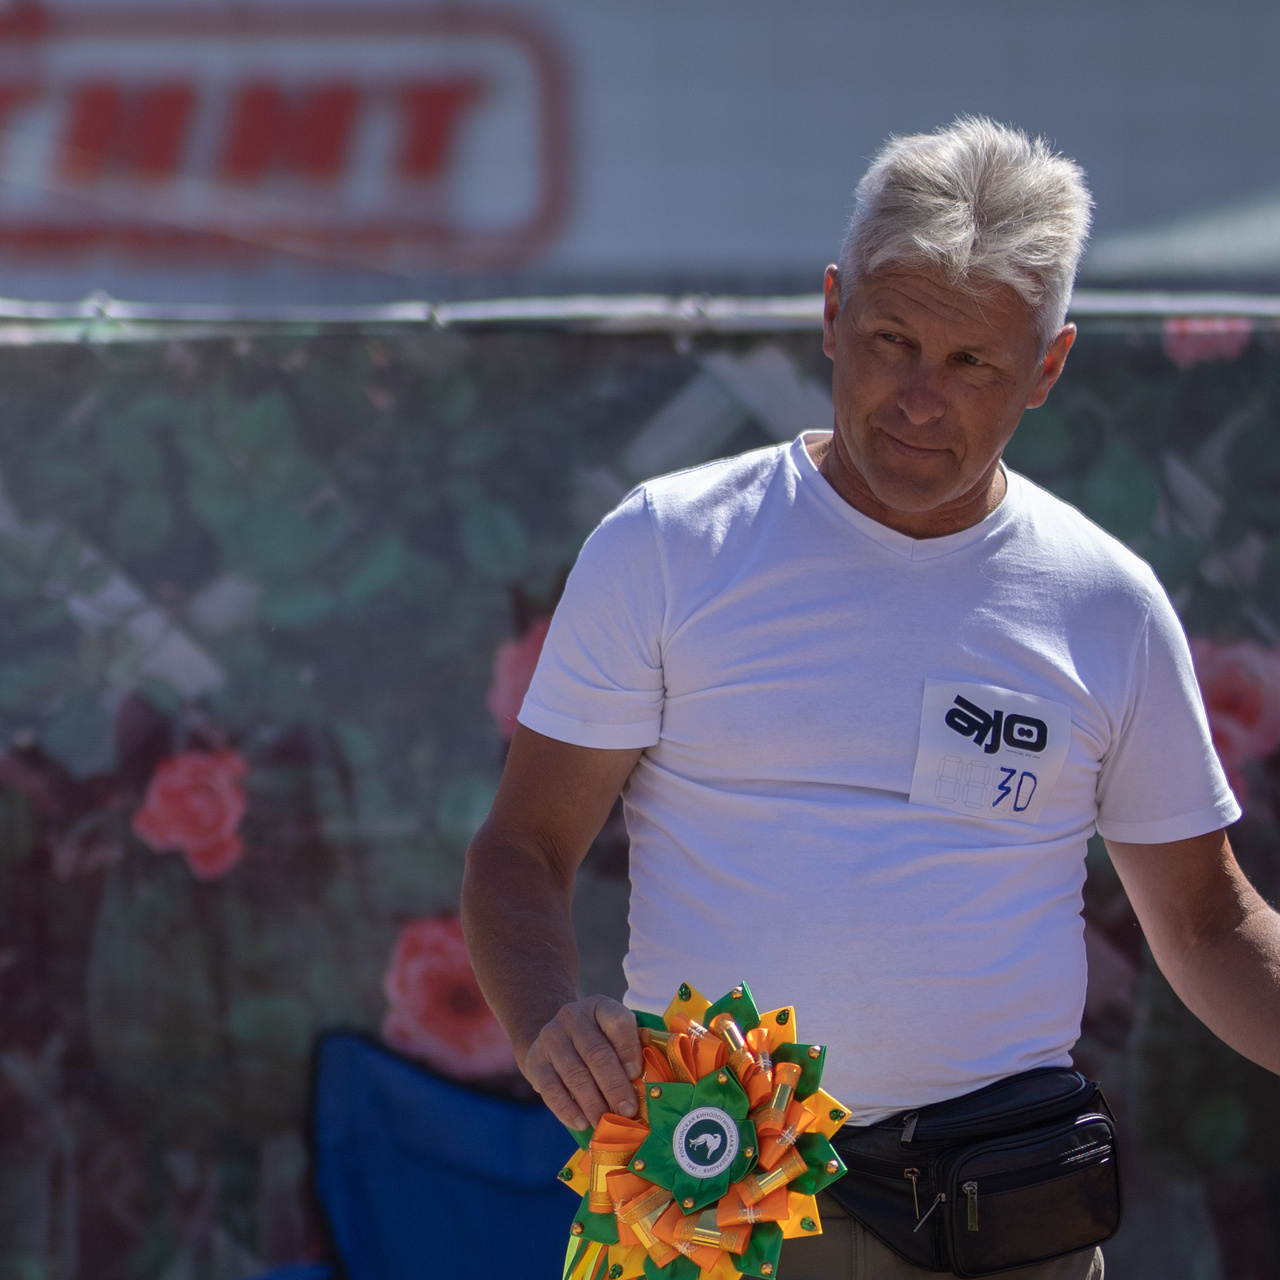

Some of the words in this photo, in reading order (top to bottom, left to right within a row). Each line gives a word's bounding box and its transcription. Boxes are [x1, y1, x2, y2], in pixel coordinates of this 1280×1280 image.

[678, 1116, 696, 1158] РОССИЙСКАЯ
[696, 1112, 734, 1147] КИНОЛОГИЧЕСКАЯ
[703, 1148, 732, 1174] ФЕДЕРАЦИЯ
